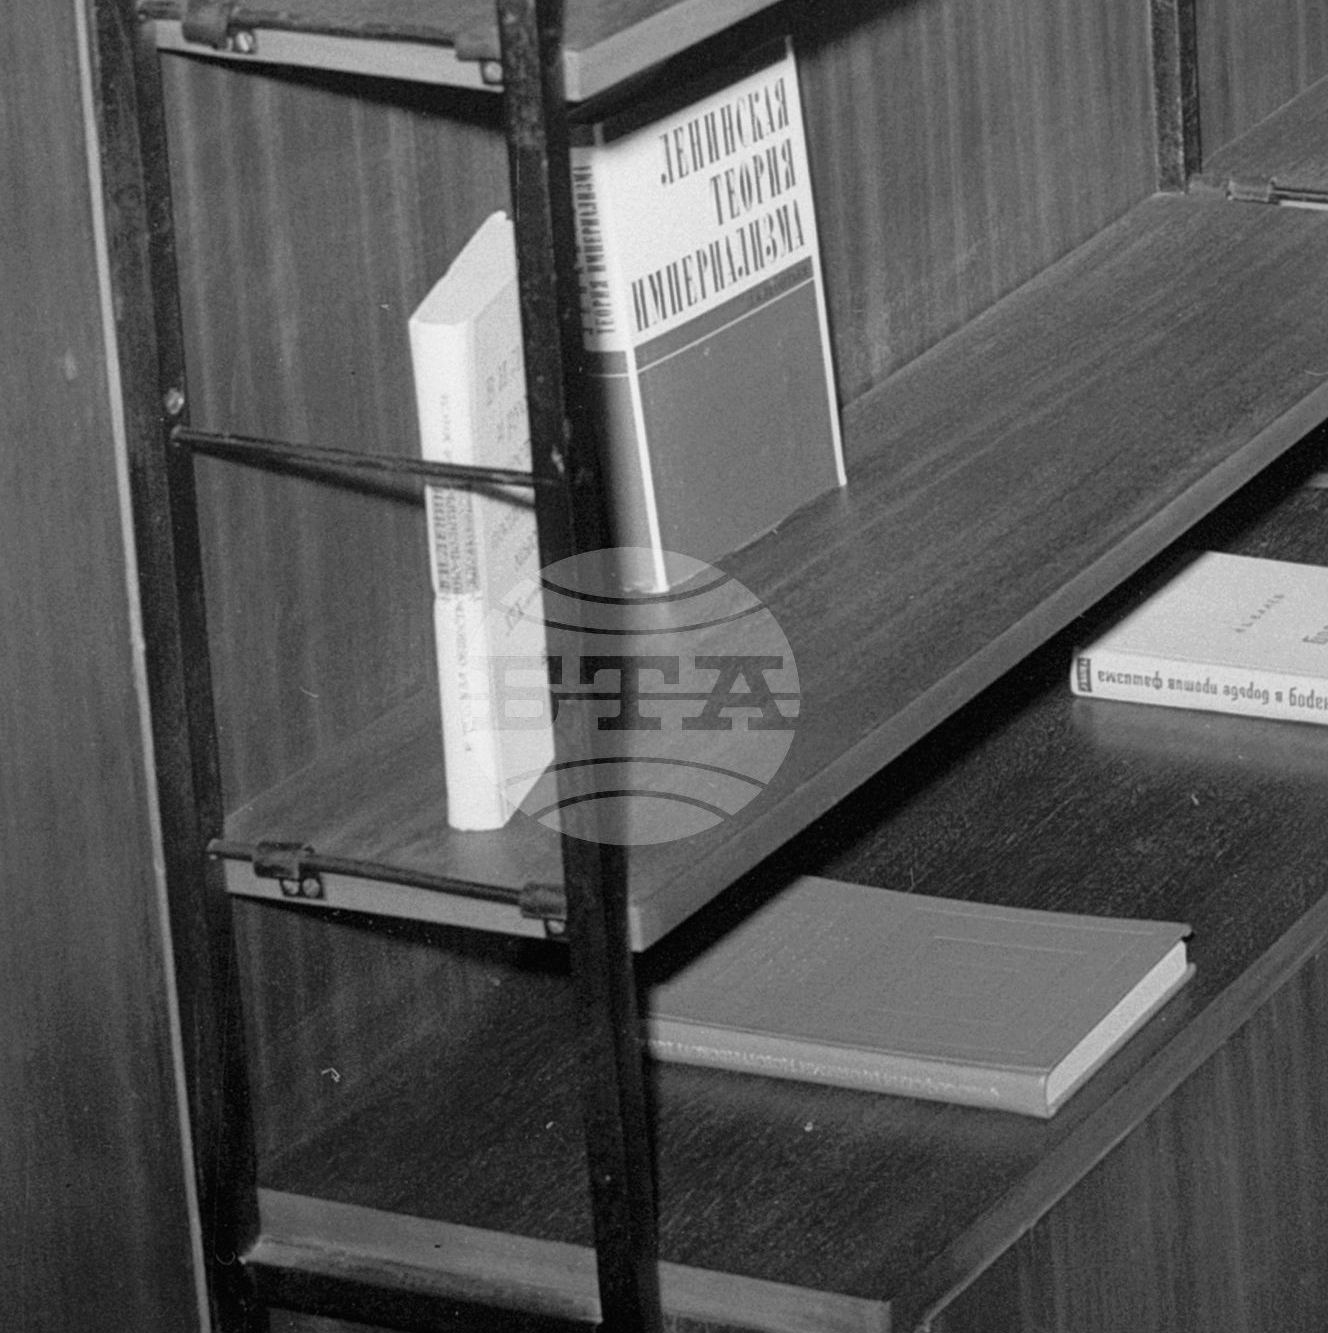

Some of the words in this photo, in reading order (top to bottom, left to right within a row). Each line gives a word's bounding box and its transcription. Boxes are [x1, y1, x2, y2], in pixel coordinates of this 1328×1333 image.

[659, 77, 790, 187] ЛЕНИНСКАЯ
[710, 137, 797, 226] ТЕОРИЯ
[631, 198, 806, 334] ИМПЕРИАЛИЗМА
[1097, 669, 1163, 690] фашизма
[1167, 678, 1219, 698] против
[1223, 683, 1271, 705] борьбе
[1275, 691, 1284, 701] в
